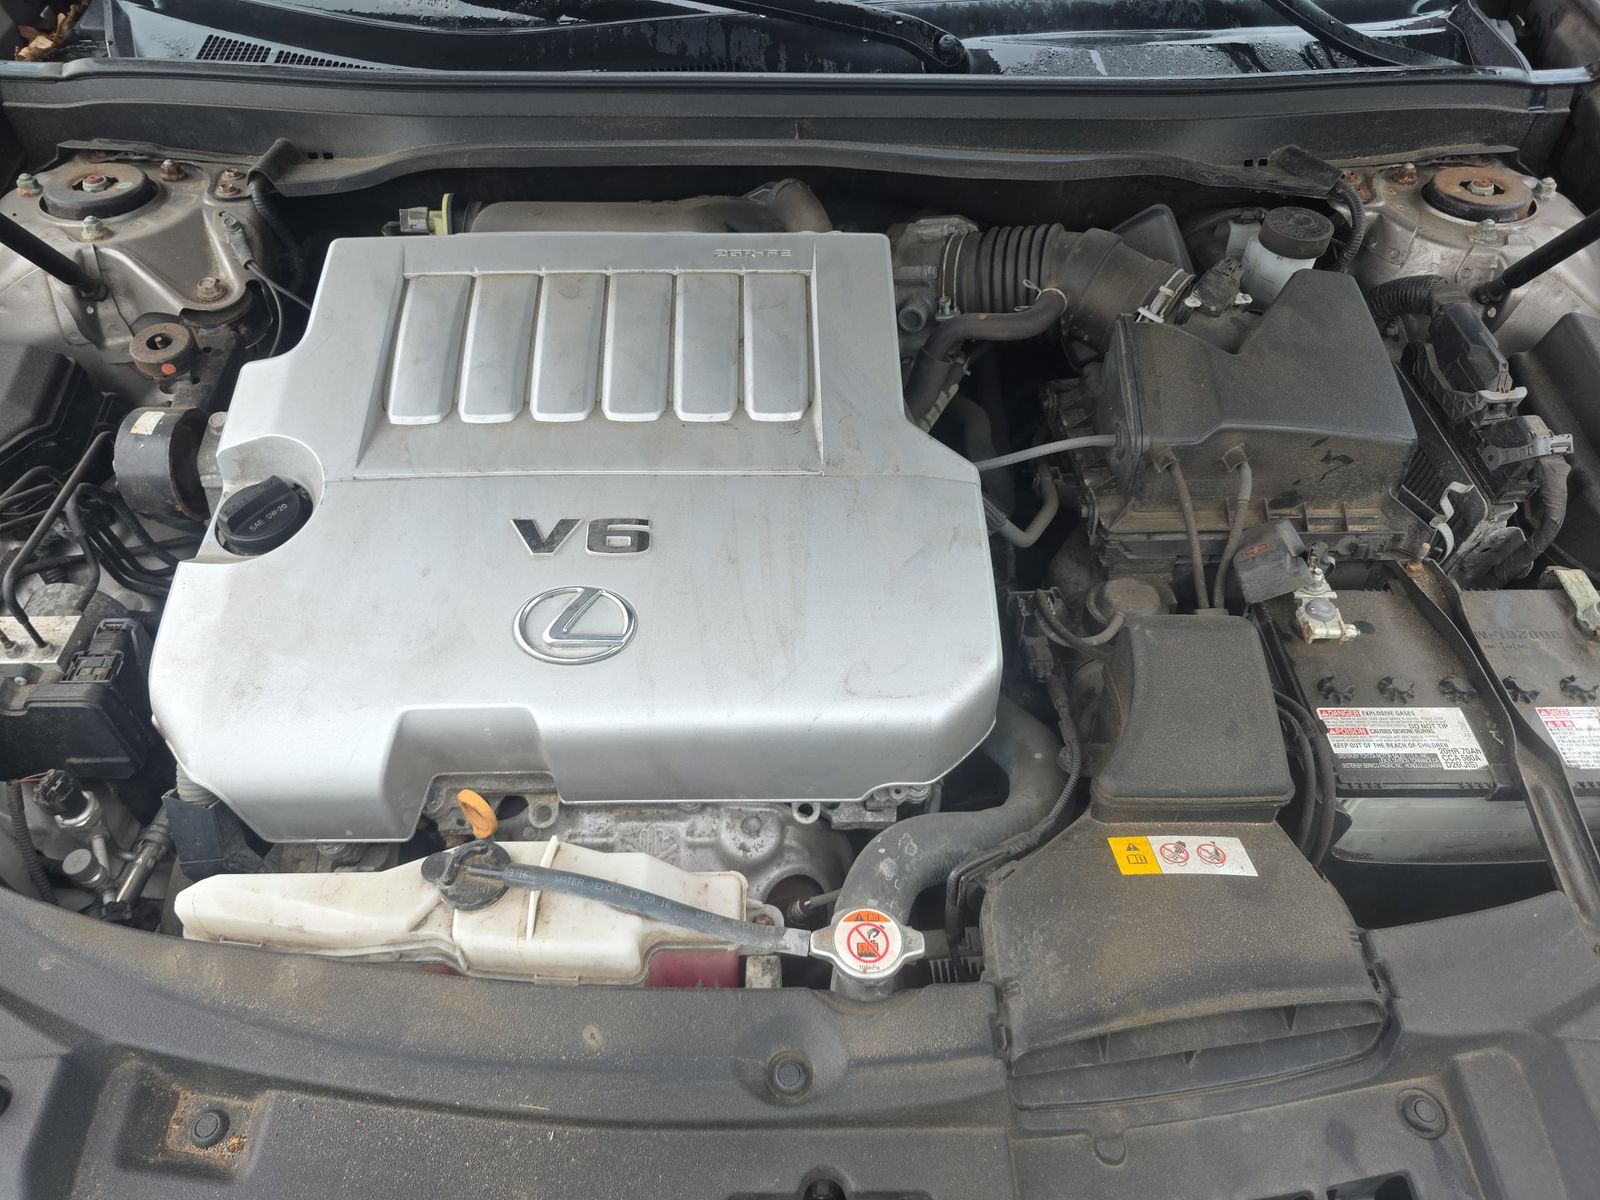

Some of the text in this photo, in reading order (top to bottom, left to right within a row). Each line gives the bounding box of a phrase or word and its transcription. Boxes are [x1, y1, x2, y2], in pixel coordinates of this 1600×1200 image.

[249, 503, 288, 532] SAE 0W-20
[509, 518, 651, 557] V6
[1438, 747, 1482, 755] 20HR 70Ah
[554, 874, 585, 887] WATER
[660, 901, 672, 909] 16
